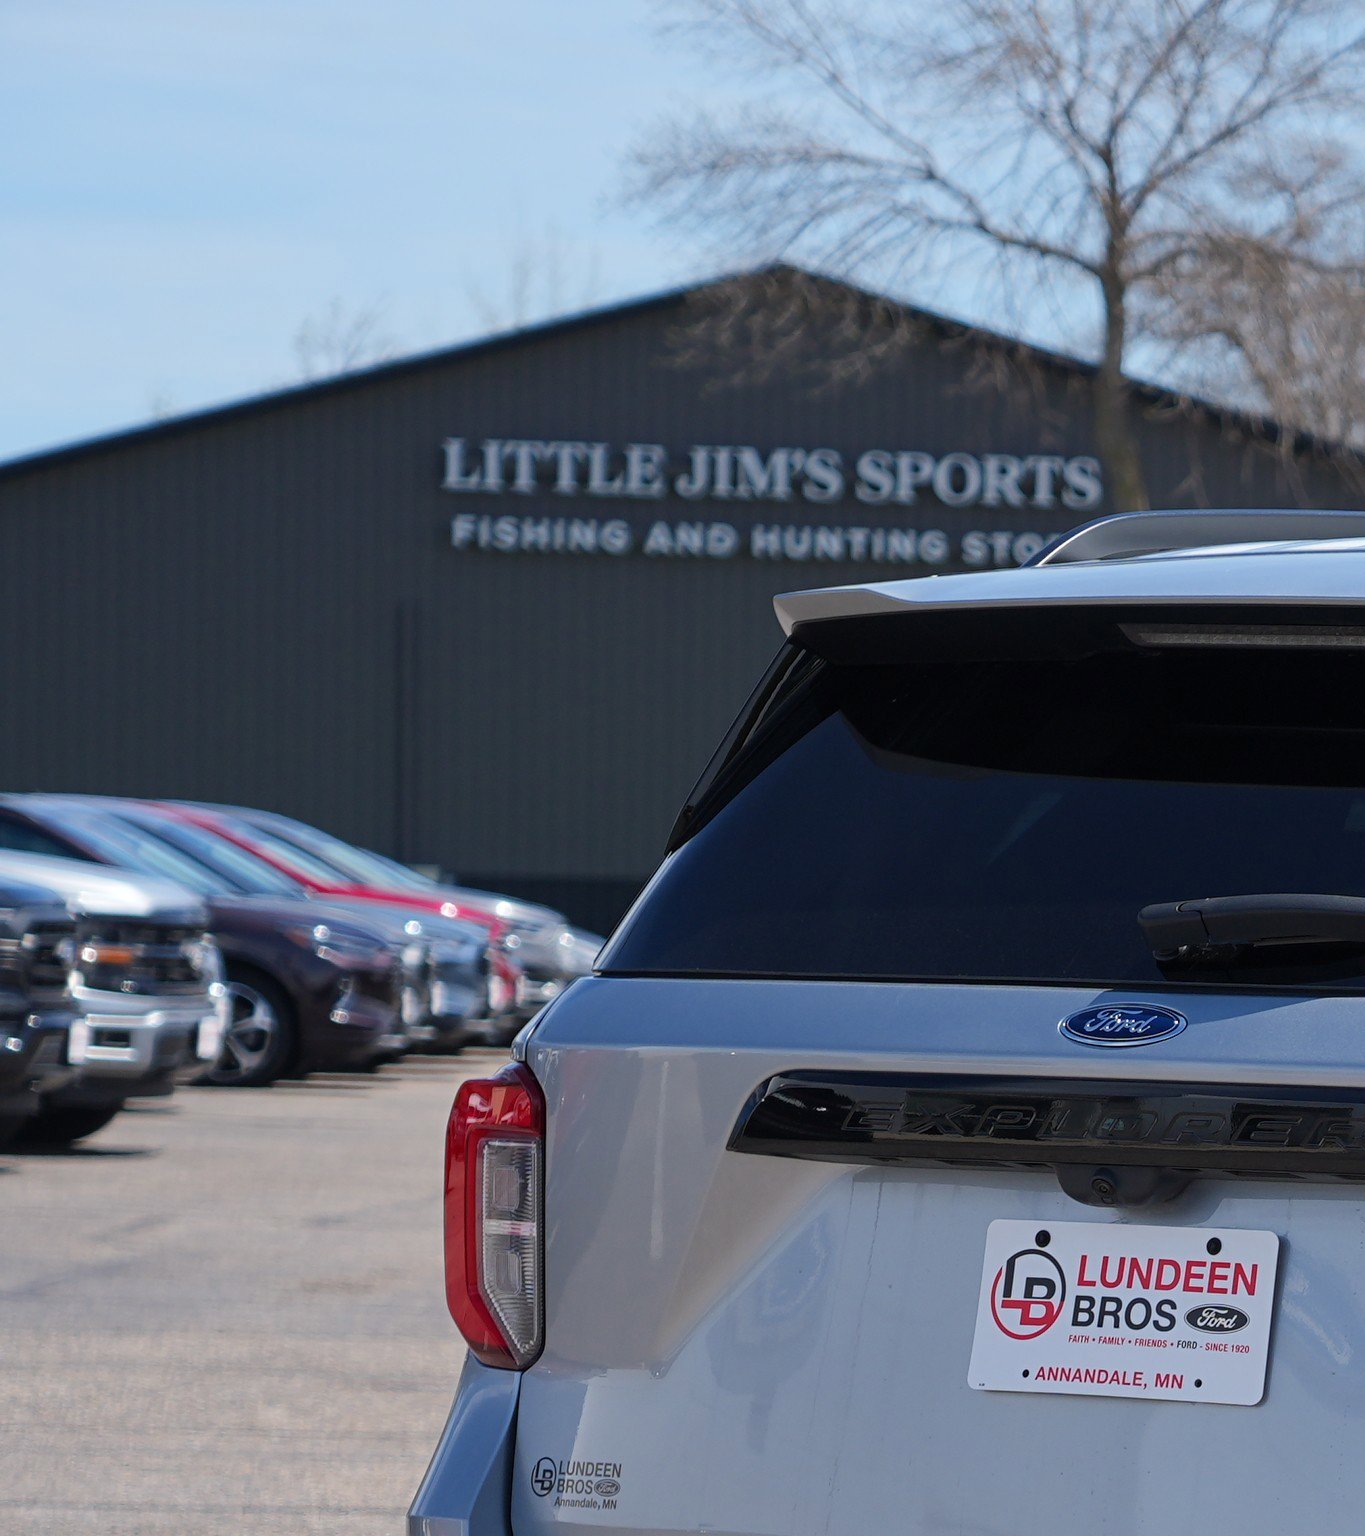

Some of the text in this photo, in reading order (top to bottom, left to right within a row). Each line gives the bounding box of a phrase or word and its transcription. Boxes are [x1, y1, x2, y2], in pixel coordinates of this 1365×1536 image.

[441, 437, 1105, 511] LITTLE JIM'S SPORTS
[451, 513, 630, 555] FISHING
[643, 520, 738, 557] AND
[751, 523, 949, 565] HUNTING
[1083, 1008, 1158, 1033] Ford
[1076, 1254, 1259, 1296] LUNDEEN
[1071, 1294, 1178, 1332] BROS
[1068, 1334, 1251, 1354] FAITH FAMILY FRIENDS FORD SINCE 1920
[1035, 1366, 1185, 1390] ANNANDALE, MN
[558, 1460, 622, 1478] LUNDEEN
[556, 1478, 594, 1495] BROS
[554, 1496, 618, 1510] Annandale, MN
